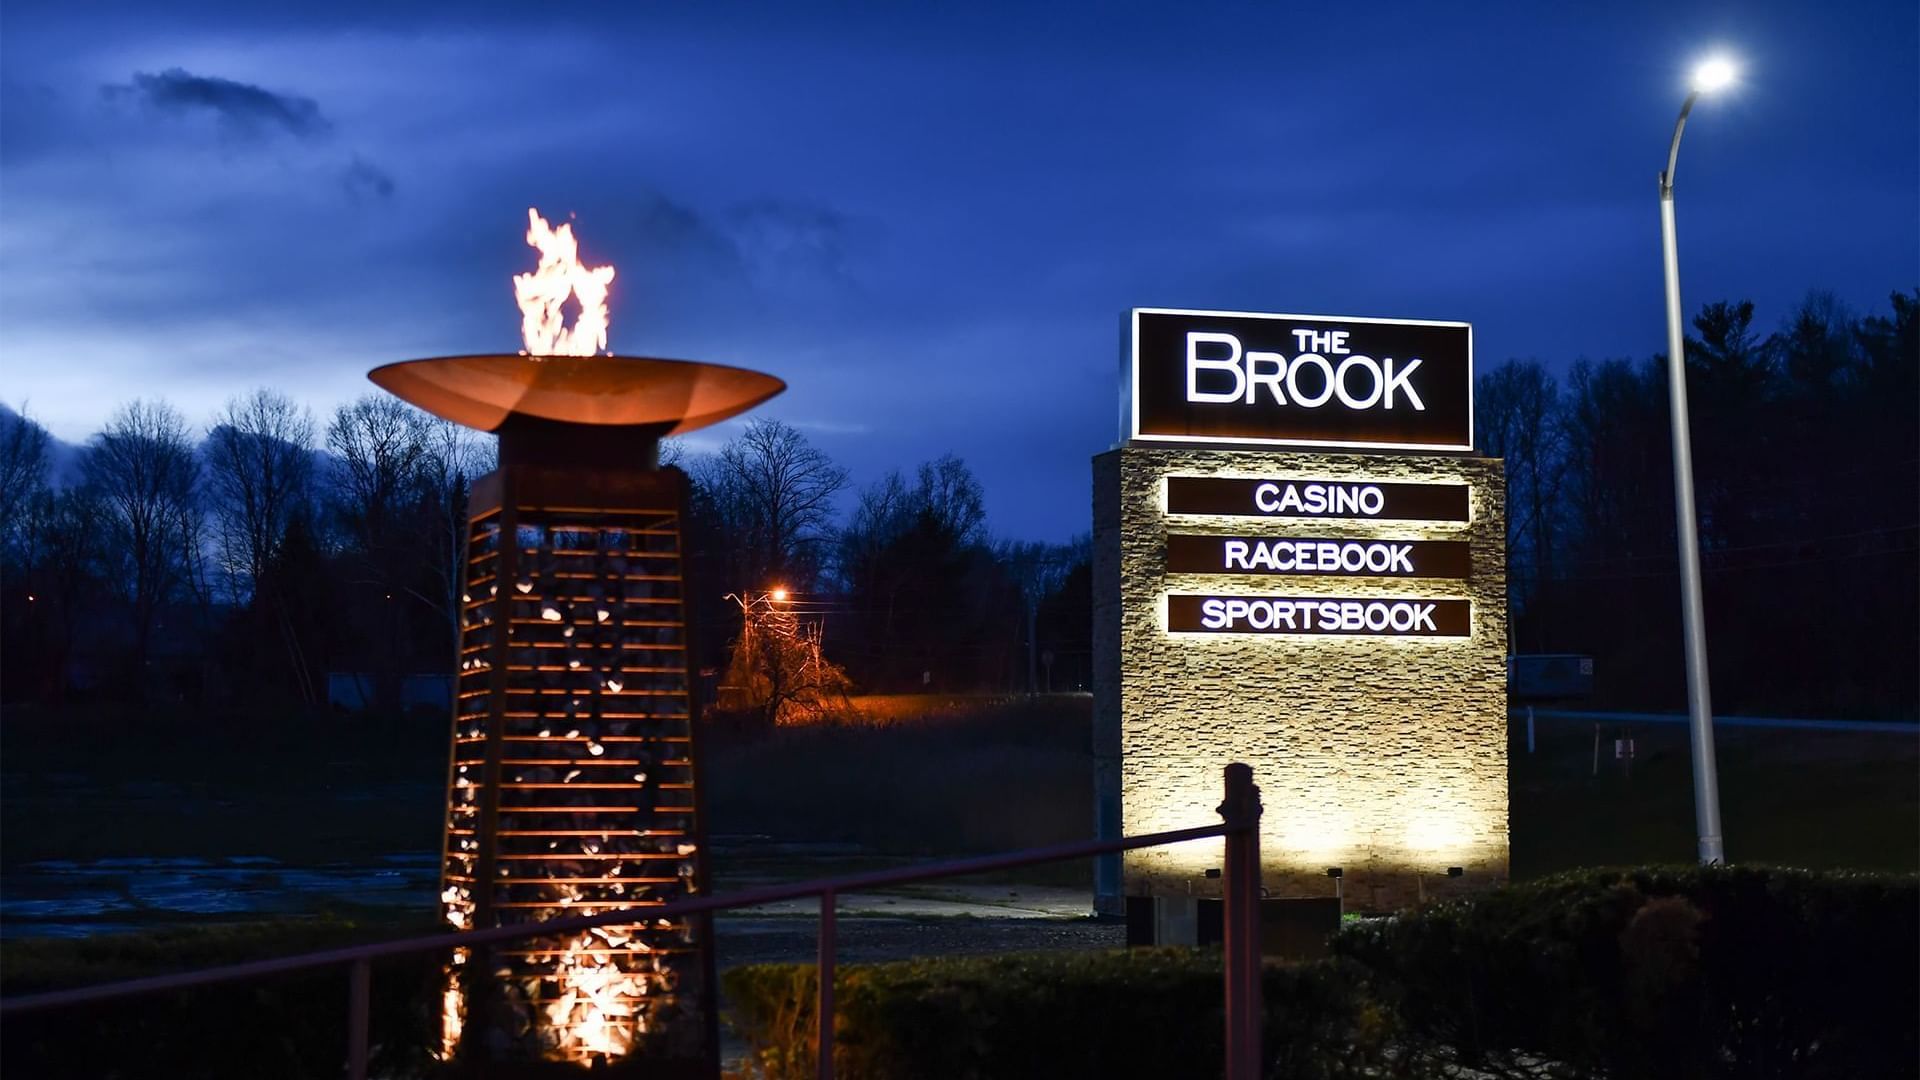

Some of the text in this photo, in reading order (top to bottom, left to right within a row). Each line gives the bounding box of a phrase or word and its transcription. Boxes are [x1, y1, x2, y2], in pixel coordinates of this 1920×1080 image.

[1292, 329, 1351, 354] THE
[1187, 331, 1426, 411] BROOK
[1255, 483, 1385, 515] CASINO
[1225, 540, 1414, 573] RACEBOOK
[1201, 599, 1437, 632] SPORTSBOOK
